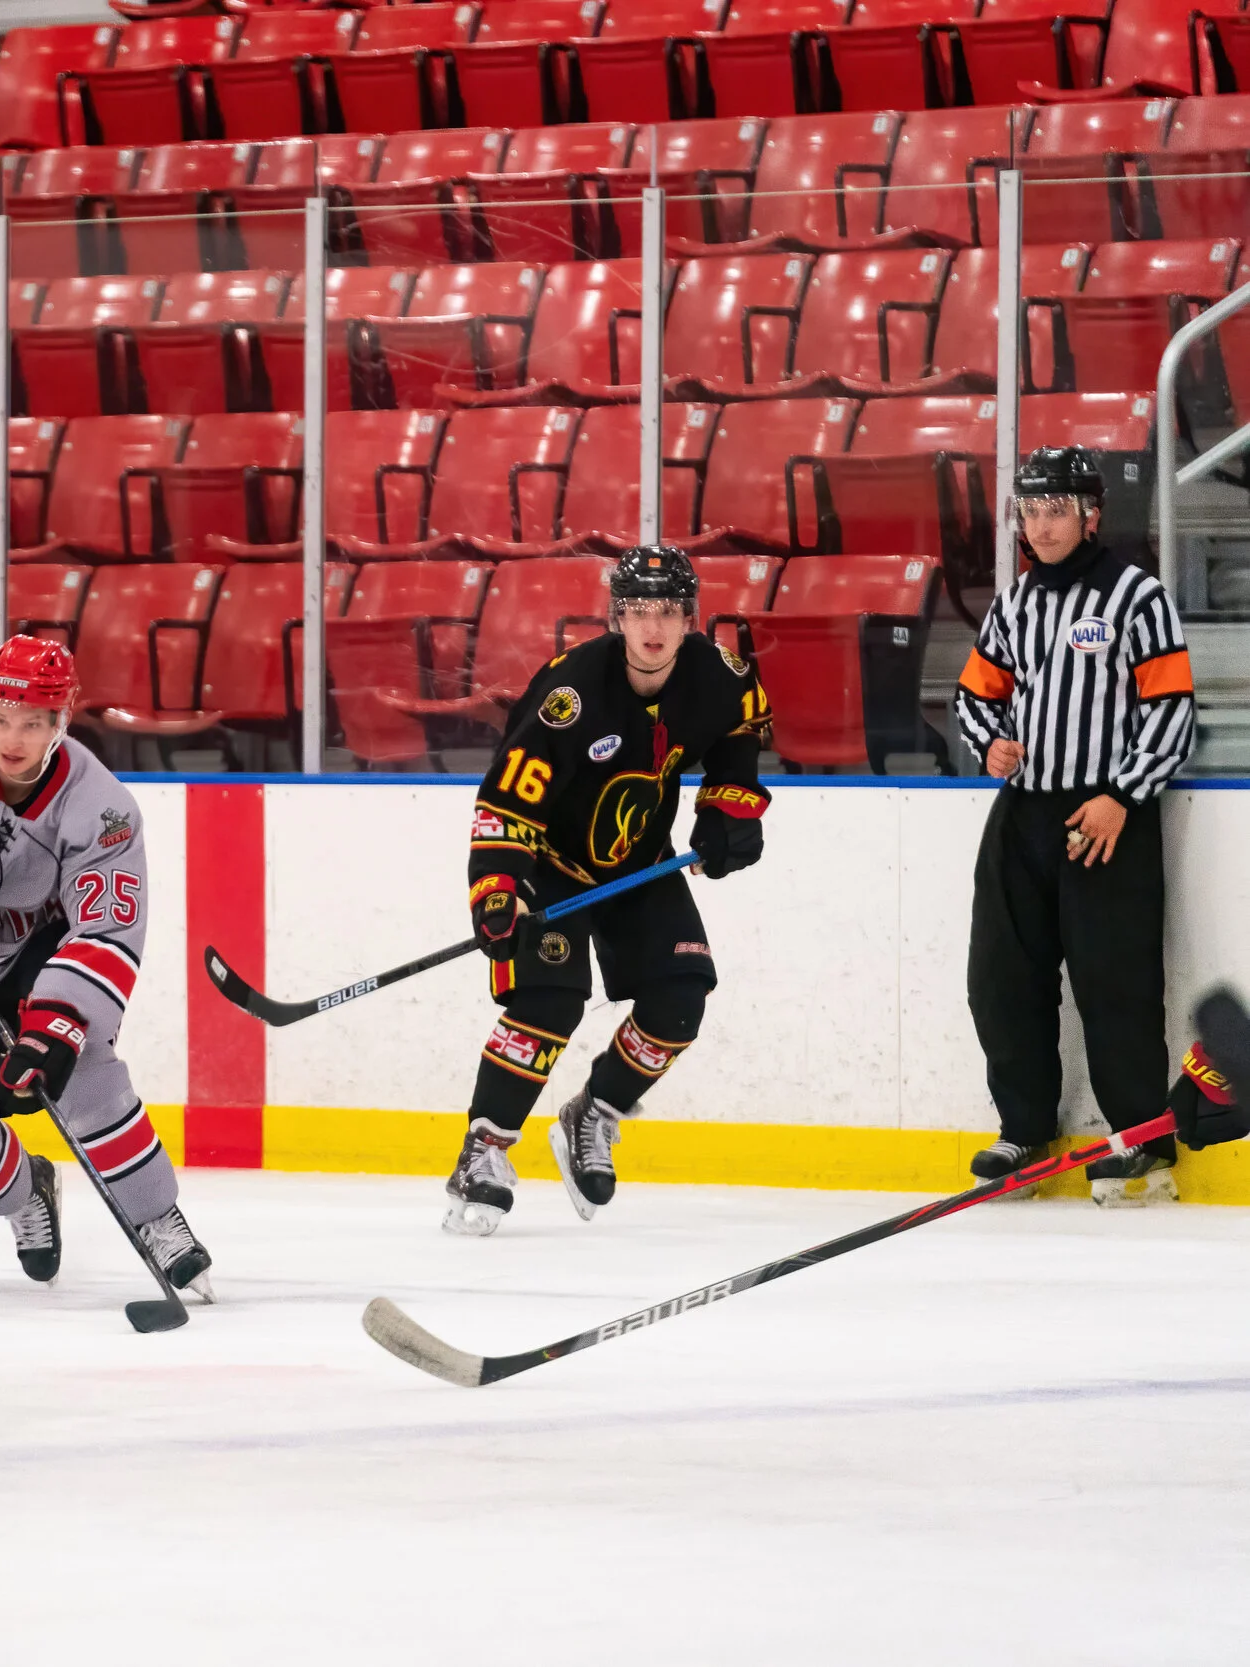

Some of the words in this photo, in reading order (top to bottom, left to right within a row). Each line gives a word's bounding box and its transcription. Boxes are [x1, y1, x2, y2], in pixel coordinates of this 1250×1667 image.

[1071, 626, 1110, 643] NAHL
[593, 736, 619, 757] NAHL
[497, 747, 553, 804] 16
[75, 869, 141, 926] 25
[317, 977, 379, 1011] BAUER
[597, 1280, 733, 1344] BAUER
